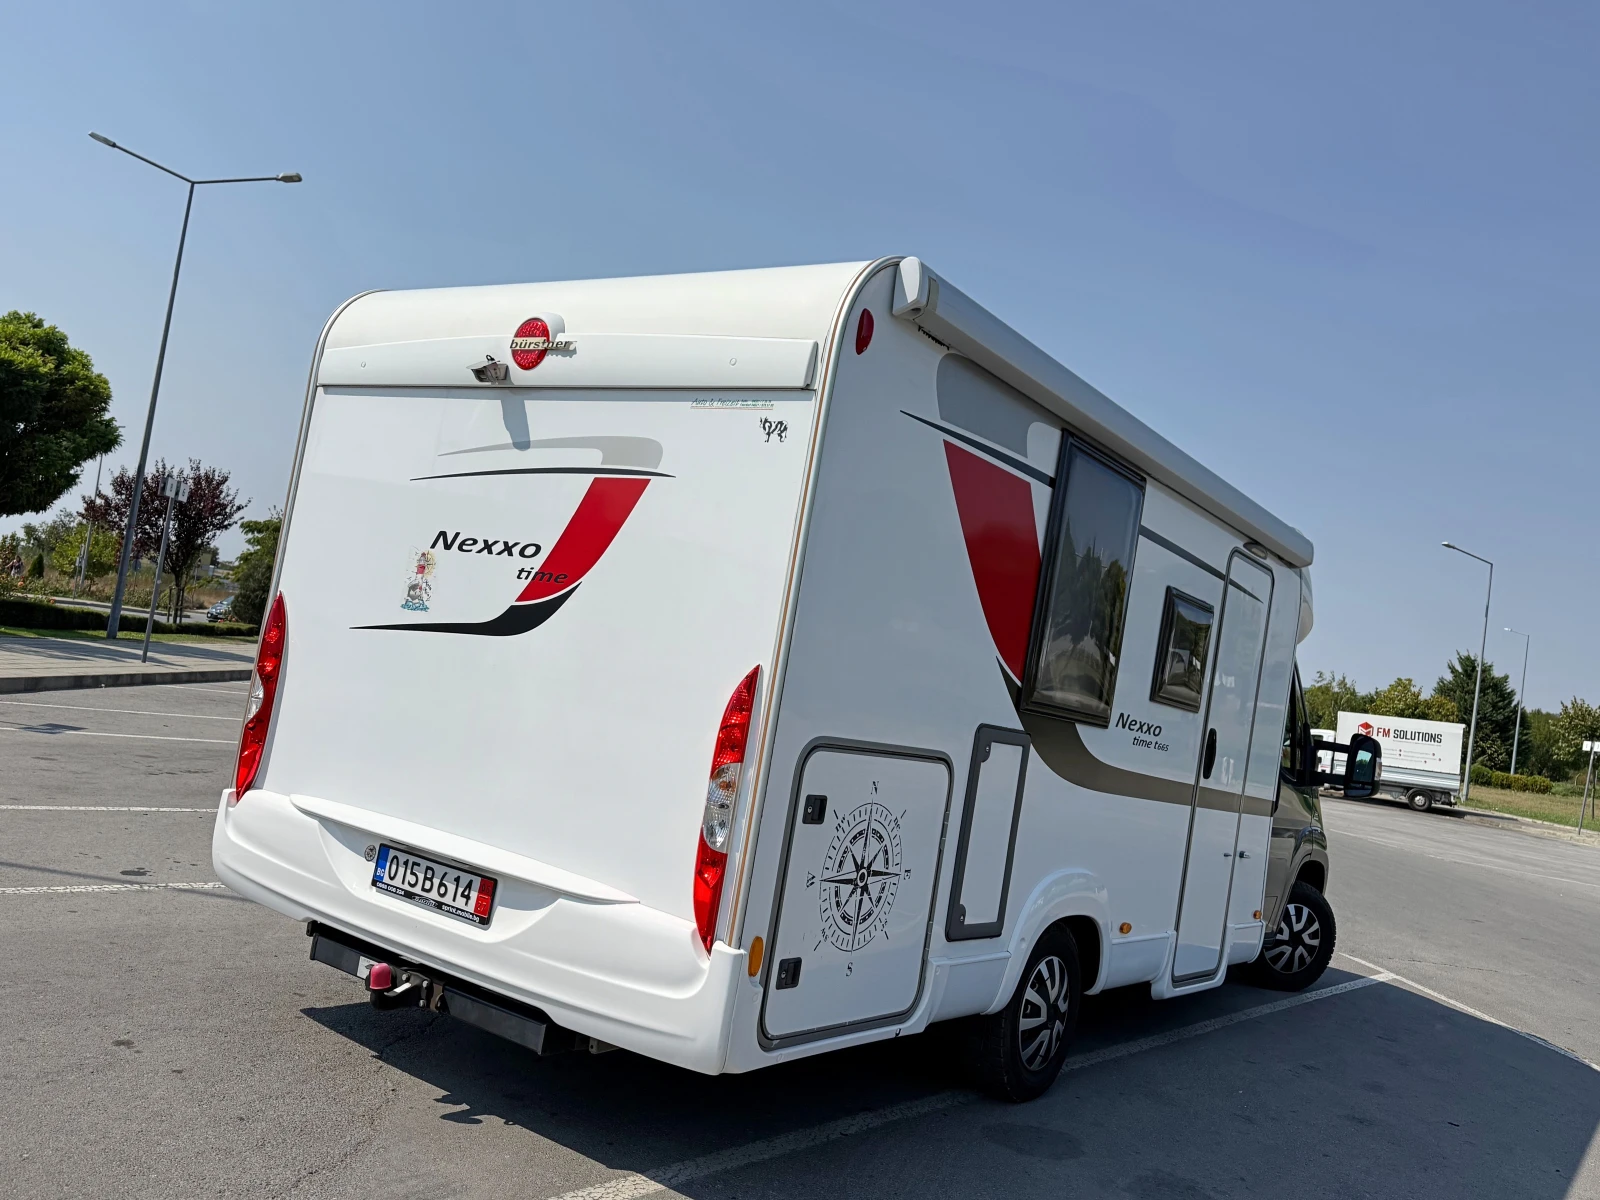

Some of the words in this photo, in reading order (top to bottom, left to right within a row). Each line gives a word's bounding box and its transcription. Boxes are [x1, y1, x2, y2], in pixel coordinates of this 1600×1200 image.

[510, 338, 570, 350] bürstner
[429, 530, 542, 559] Nexxo
[516, 566, 569, 584] time
[1115, 712, 1162, 737] Nexxo
[1132, 736, 1153, 749] time
[1376, 727, 1391, 738] FM
[1393, 729, 1443, 744] SOLUTIONS
[870, 780, 880, 795] N
[376, 867, 385, 877] BG
[388, 854, 474, 907] 015B614
